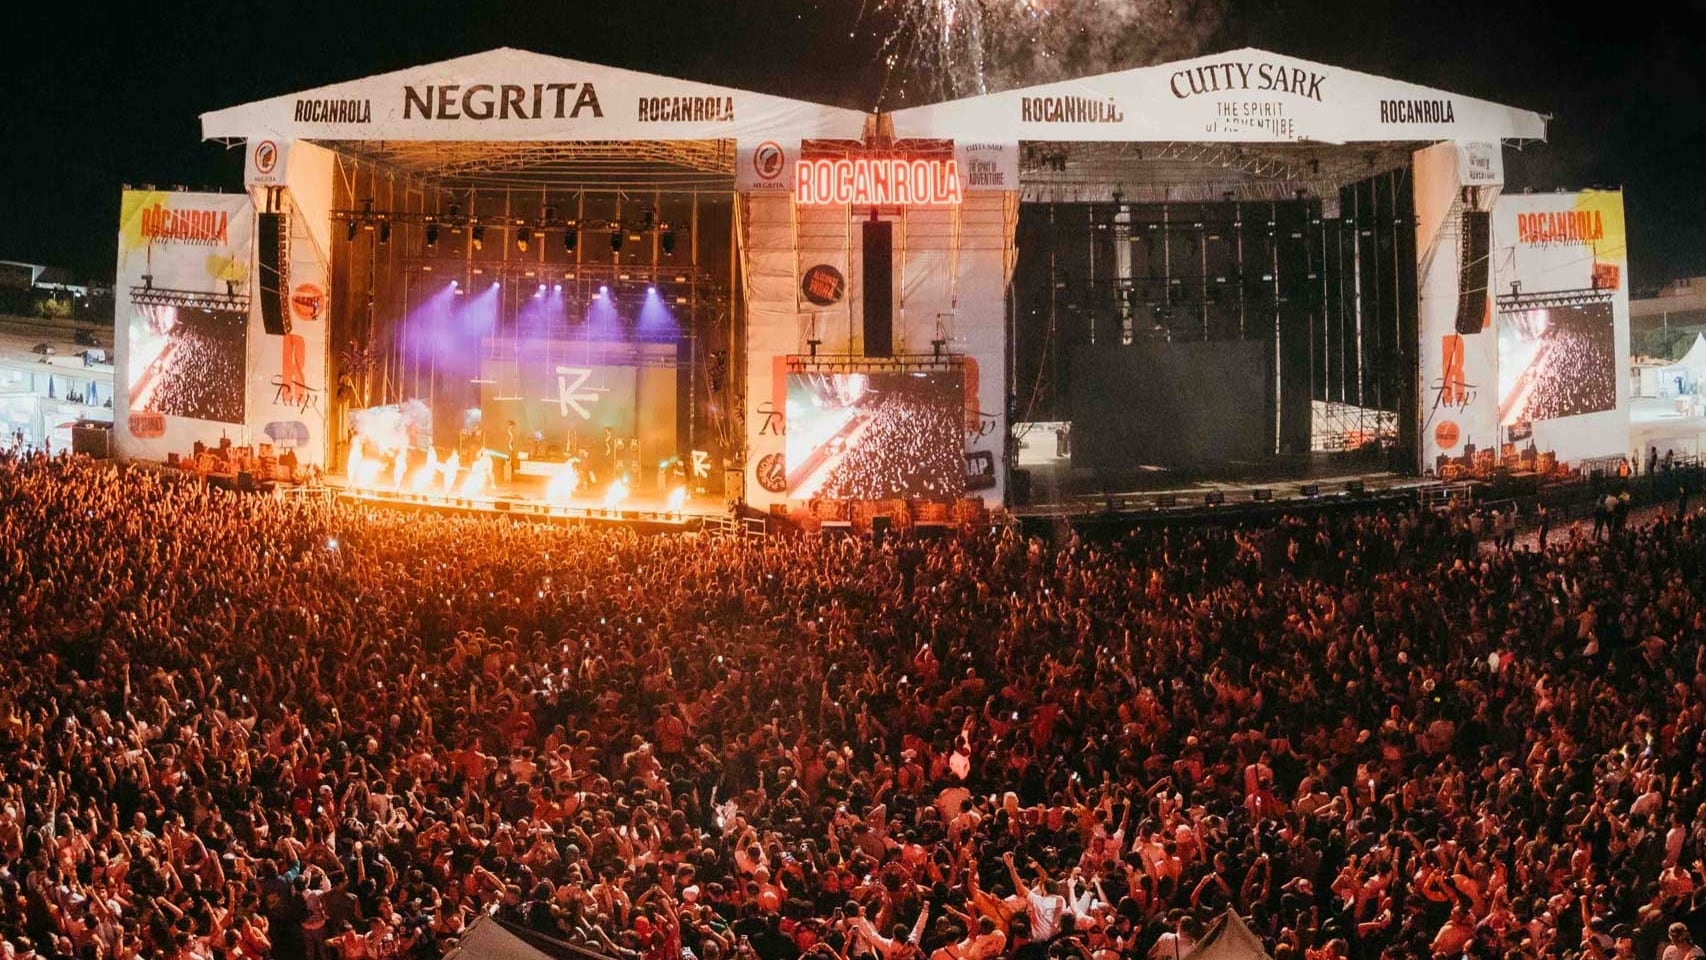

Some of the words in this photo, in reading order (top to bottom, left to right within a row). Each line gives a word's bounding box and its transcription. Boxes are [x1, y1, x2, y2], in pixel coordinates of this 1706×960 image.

[1170, 62, 1252, 99] CUTTY
[1257, 63, 1326, 102] SARK
[294, 99, 371, 124] ROCANROLA
[403, 82, 604, 120] NEGRITA
[638, 97, 734, 122] ROCANROLA
[1217, 102, 1238, 116] THE
[1243, 102, 1283, 116] SPIRIT
[1380, 99, 1455, 123] ROCANROLA
[795, 159, 963, 205] ROCANROLA
[141, 203, 228, 247] ROCANROLA
[1518, 210, 1603, 242] ROCANROLA
